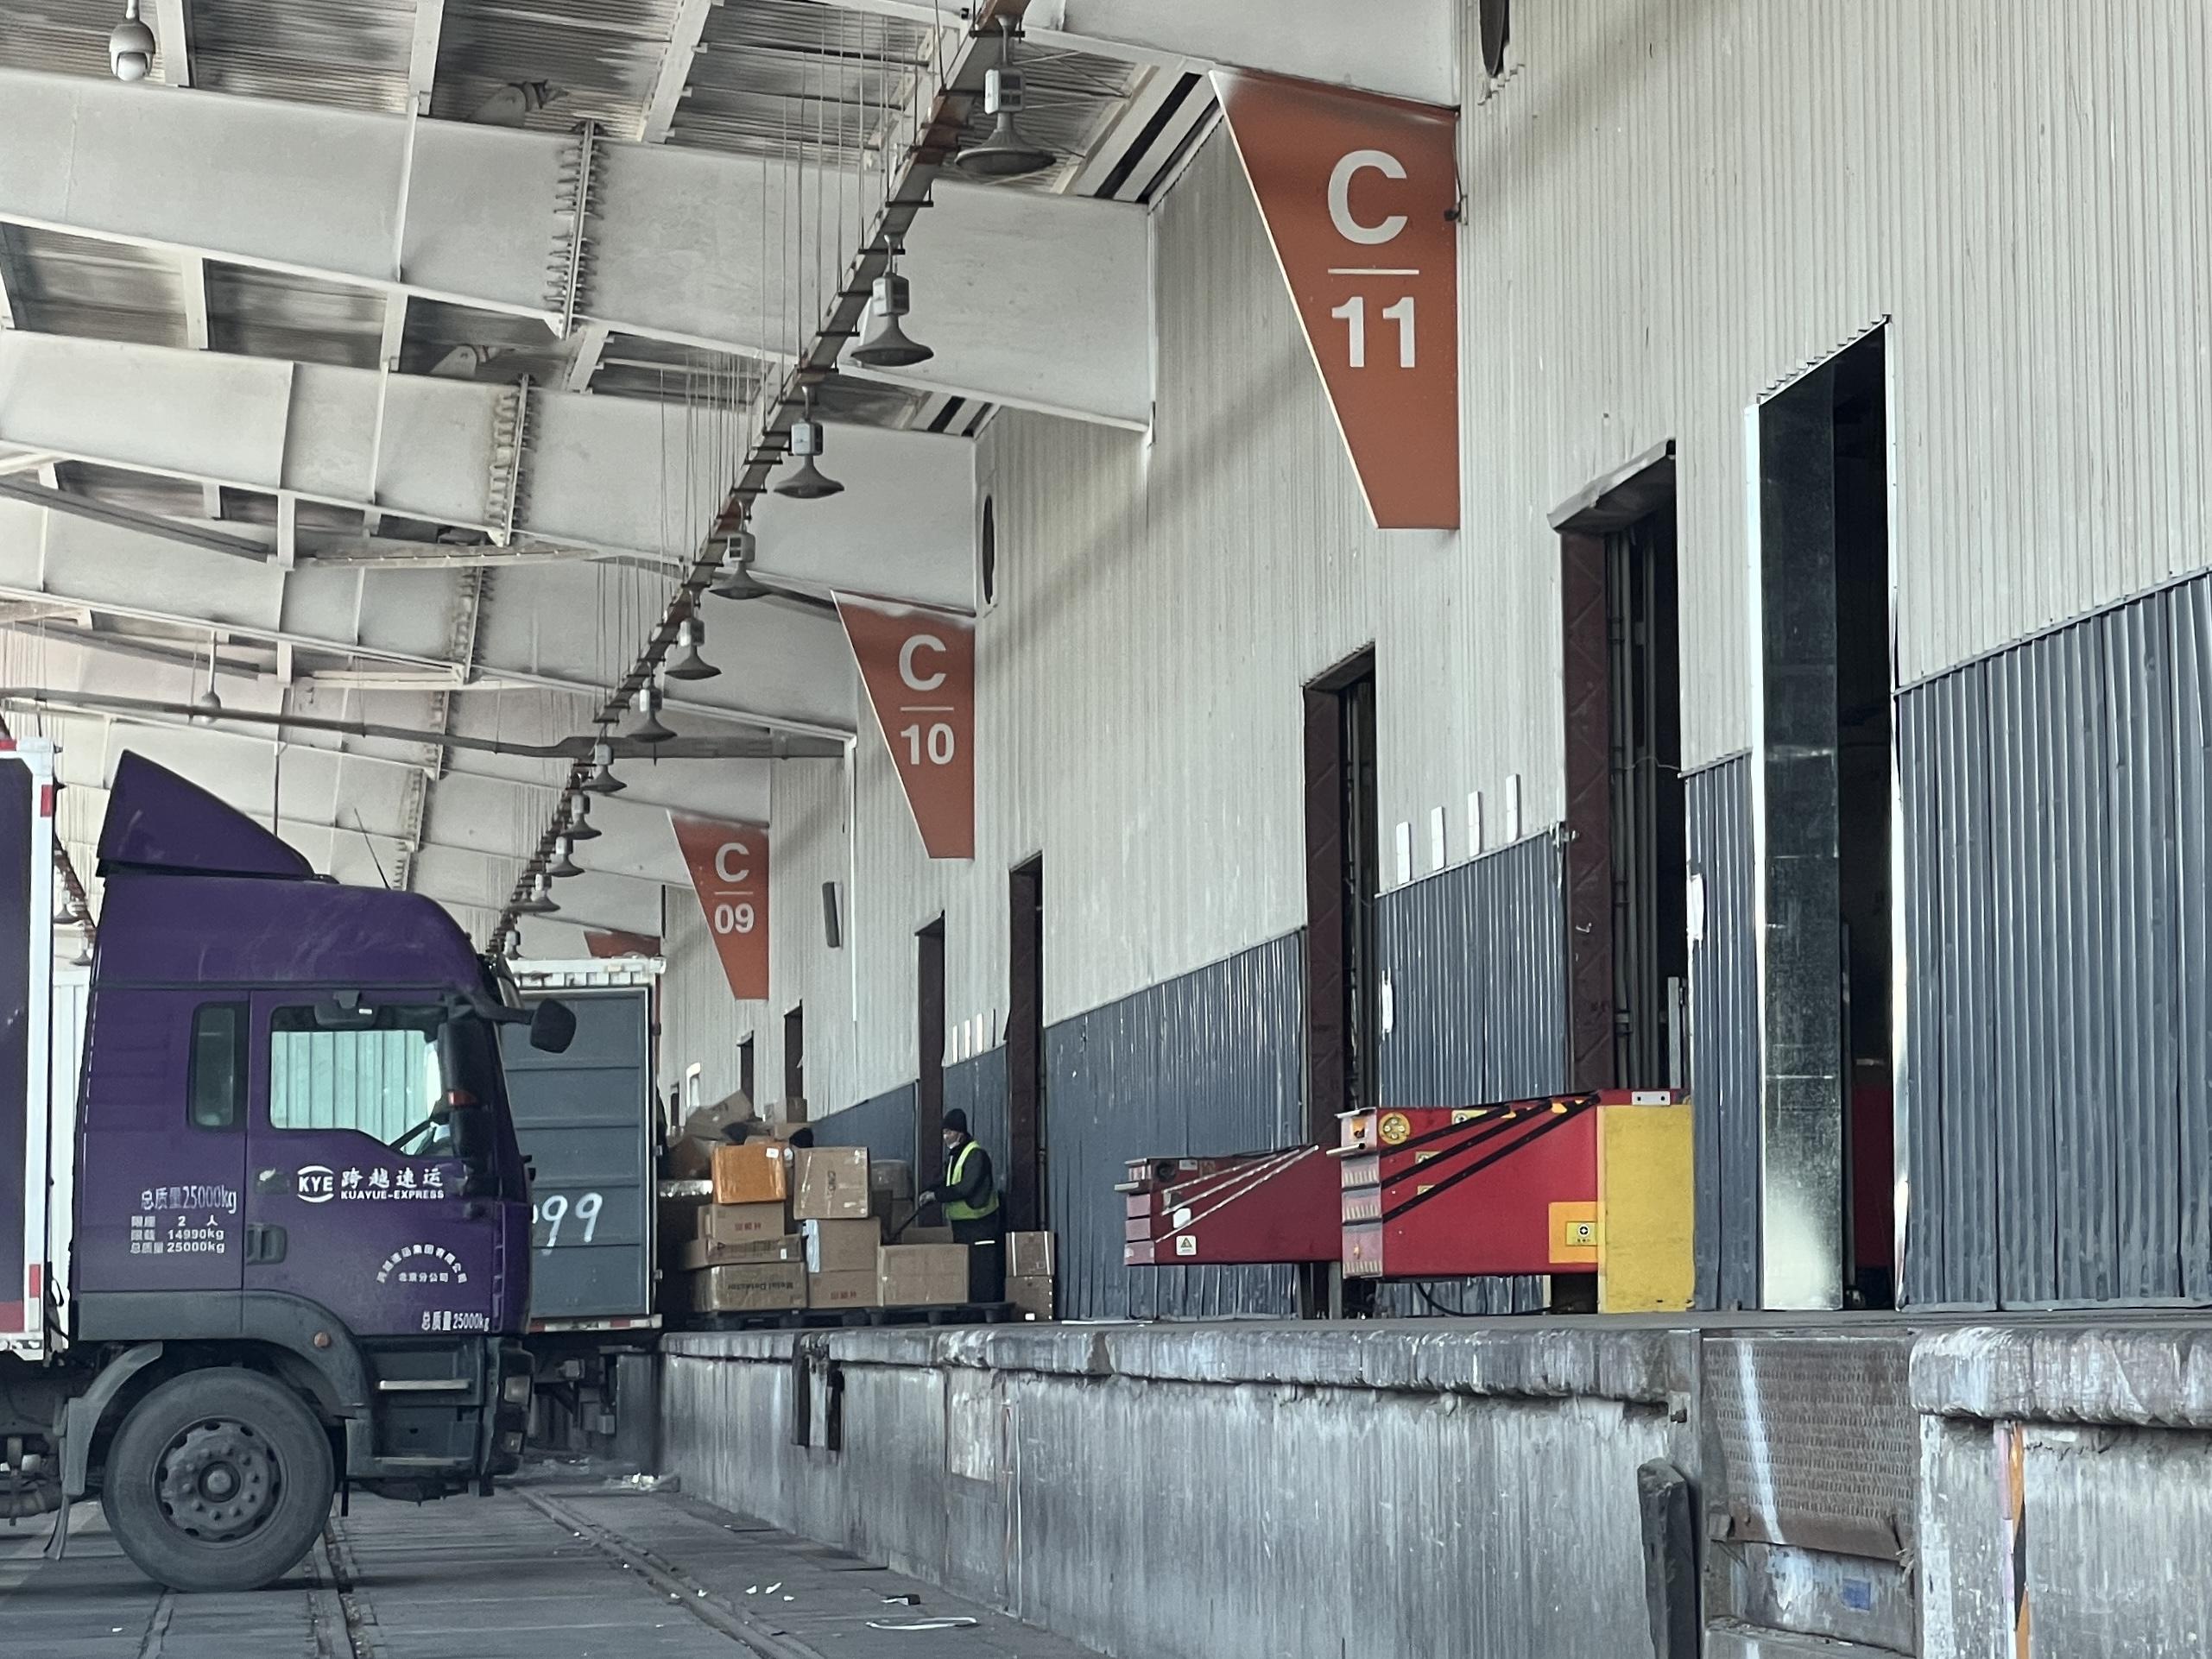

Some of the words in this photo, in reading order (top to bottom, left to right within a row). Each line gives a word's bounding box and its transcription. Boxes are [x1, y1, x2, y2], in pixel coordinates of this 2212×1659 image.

[1328, 149, 1408, 244] C
[1331, 296, 1415, 368] 11
[899, 634, 947, 691] C
[901, 722, 955, 765] 10
[715, 842, 749, 882] C
[714, 903, 755, 934] 09
[298, 1176, 334, 1193] KYE
[340, 1167, 444, 1189] 跨越速运
[340, 1189, 445, 1200] KUAYUE-EXPRESS
[178, 1215, 186, 1227] 2
[206, 1214, 218, 1226] 人
[532, 1192, 603, 1256] 99
[167, 1241, 225, 1253] 25000kg
